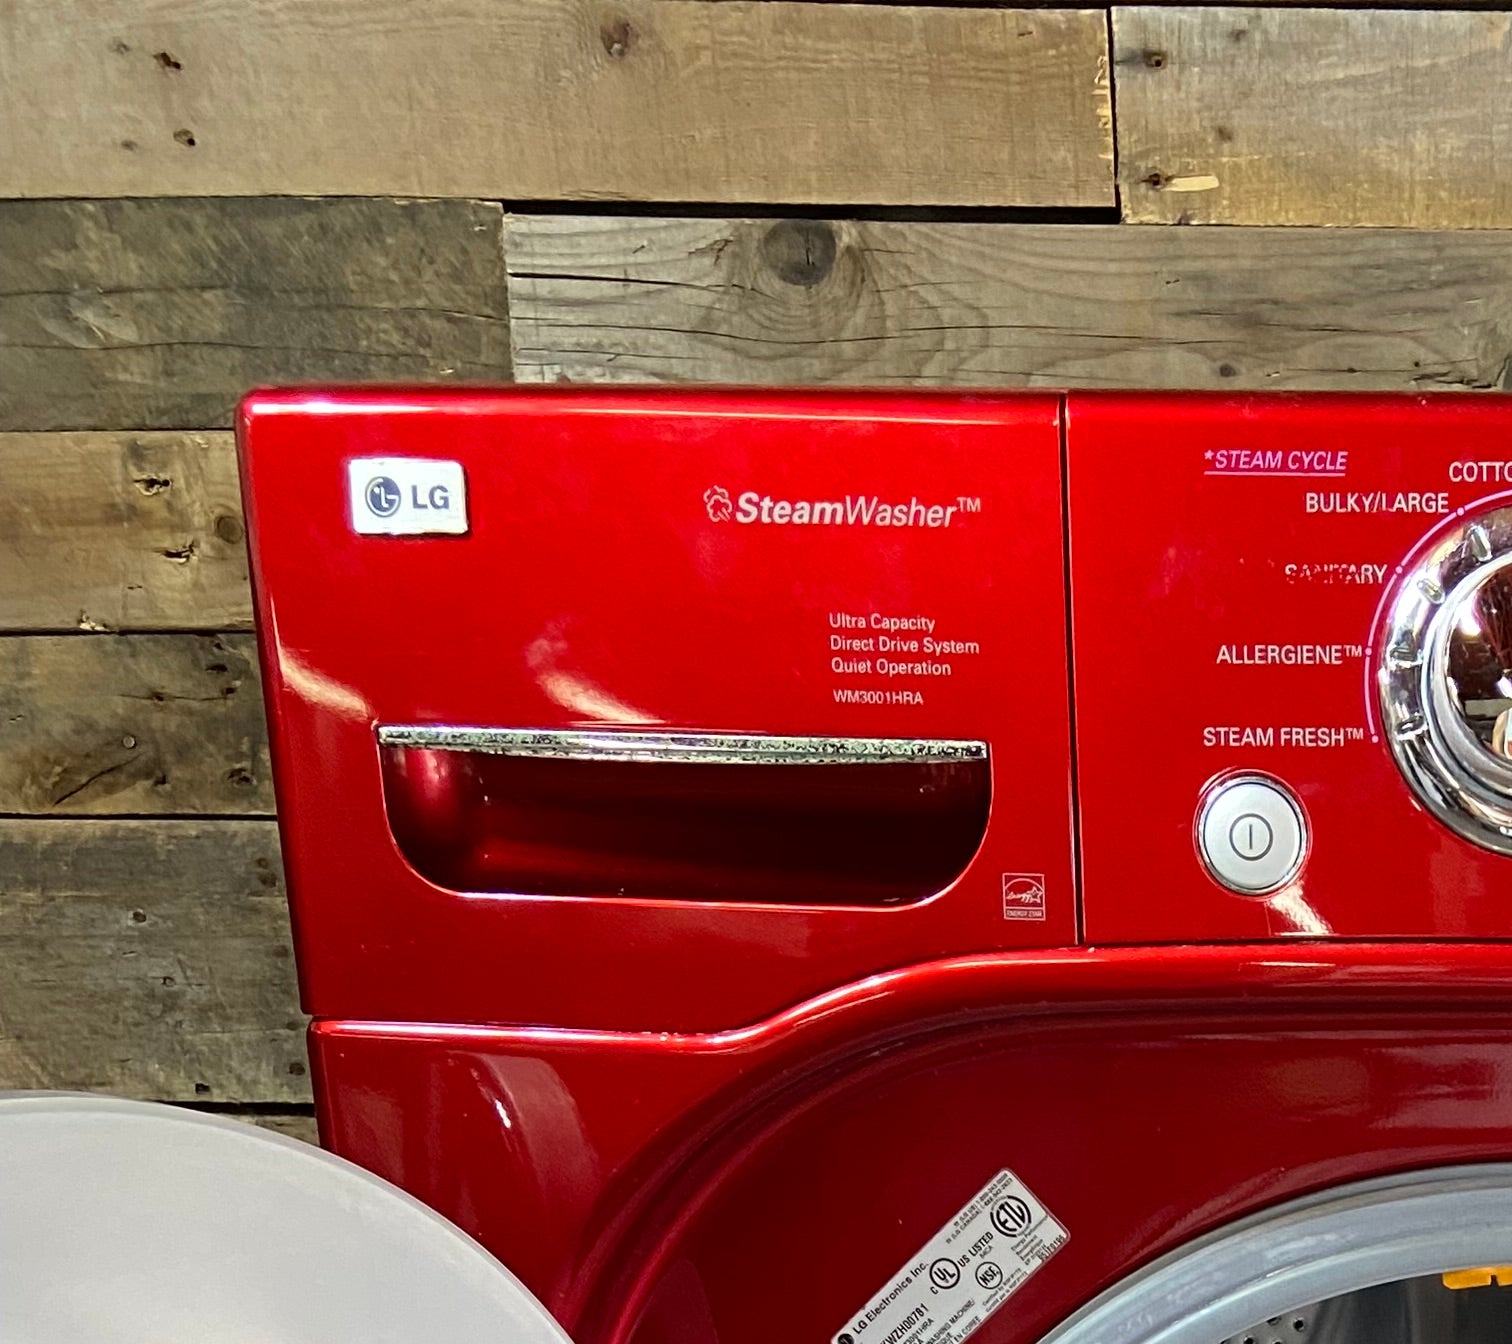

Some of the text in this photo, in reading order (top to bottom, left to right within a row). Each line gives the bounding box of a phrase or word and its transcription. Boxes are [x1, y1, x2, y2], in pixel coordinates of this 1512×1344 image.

[1288, 451, 1348, 471] CYCLE
[411, 484, 450, 510] LG
[1306, 492, 1449, 514] BULKY/LARGE
[829, 612, 935, 633] Ultra Capacity
[830, 635, 980, 656] Direct Drive System
[831, 658, 952, 677] Quiet Operation
[833, 689, 924, 706] WM3001HRA
[1203, 727, 1273, 748] STEAM
[929, 1230, 993, 1295] C US LISTED
[933, 1267, 956, 1283] UL
[851, 1262, 929, 1334] LG Electronics Inc.
[952, 1333, 963, 1342] EN
